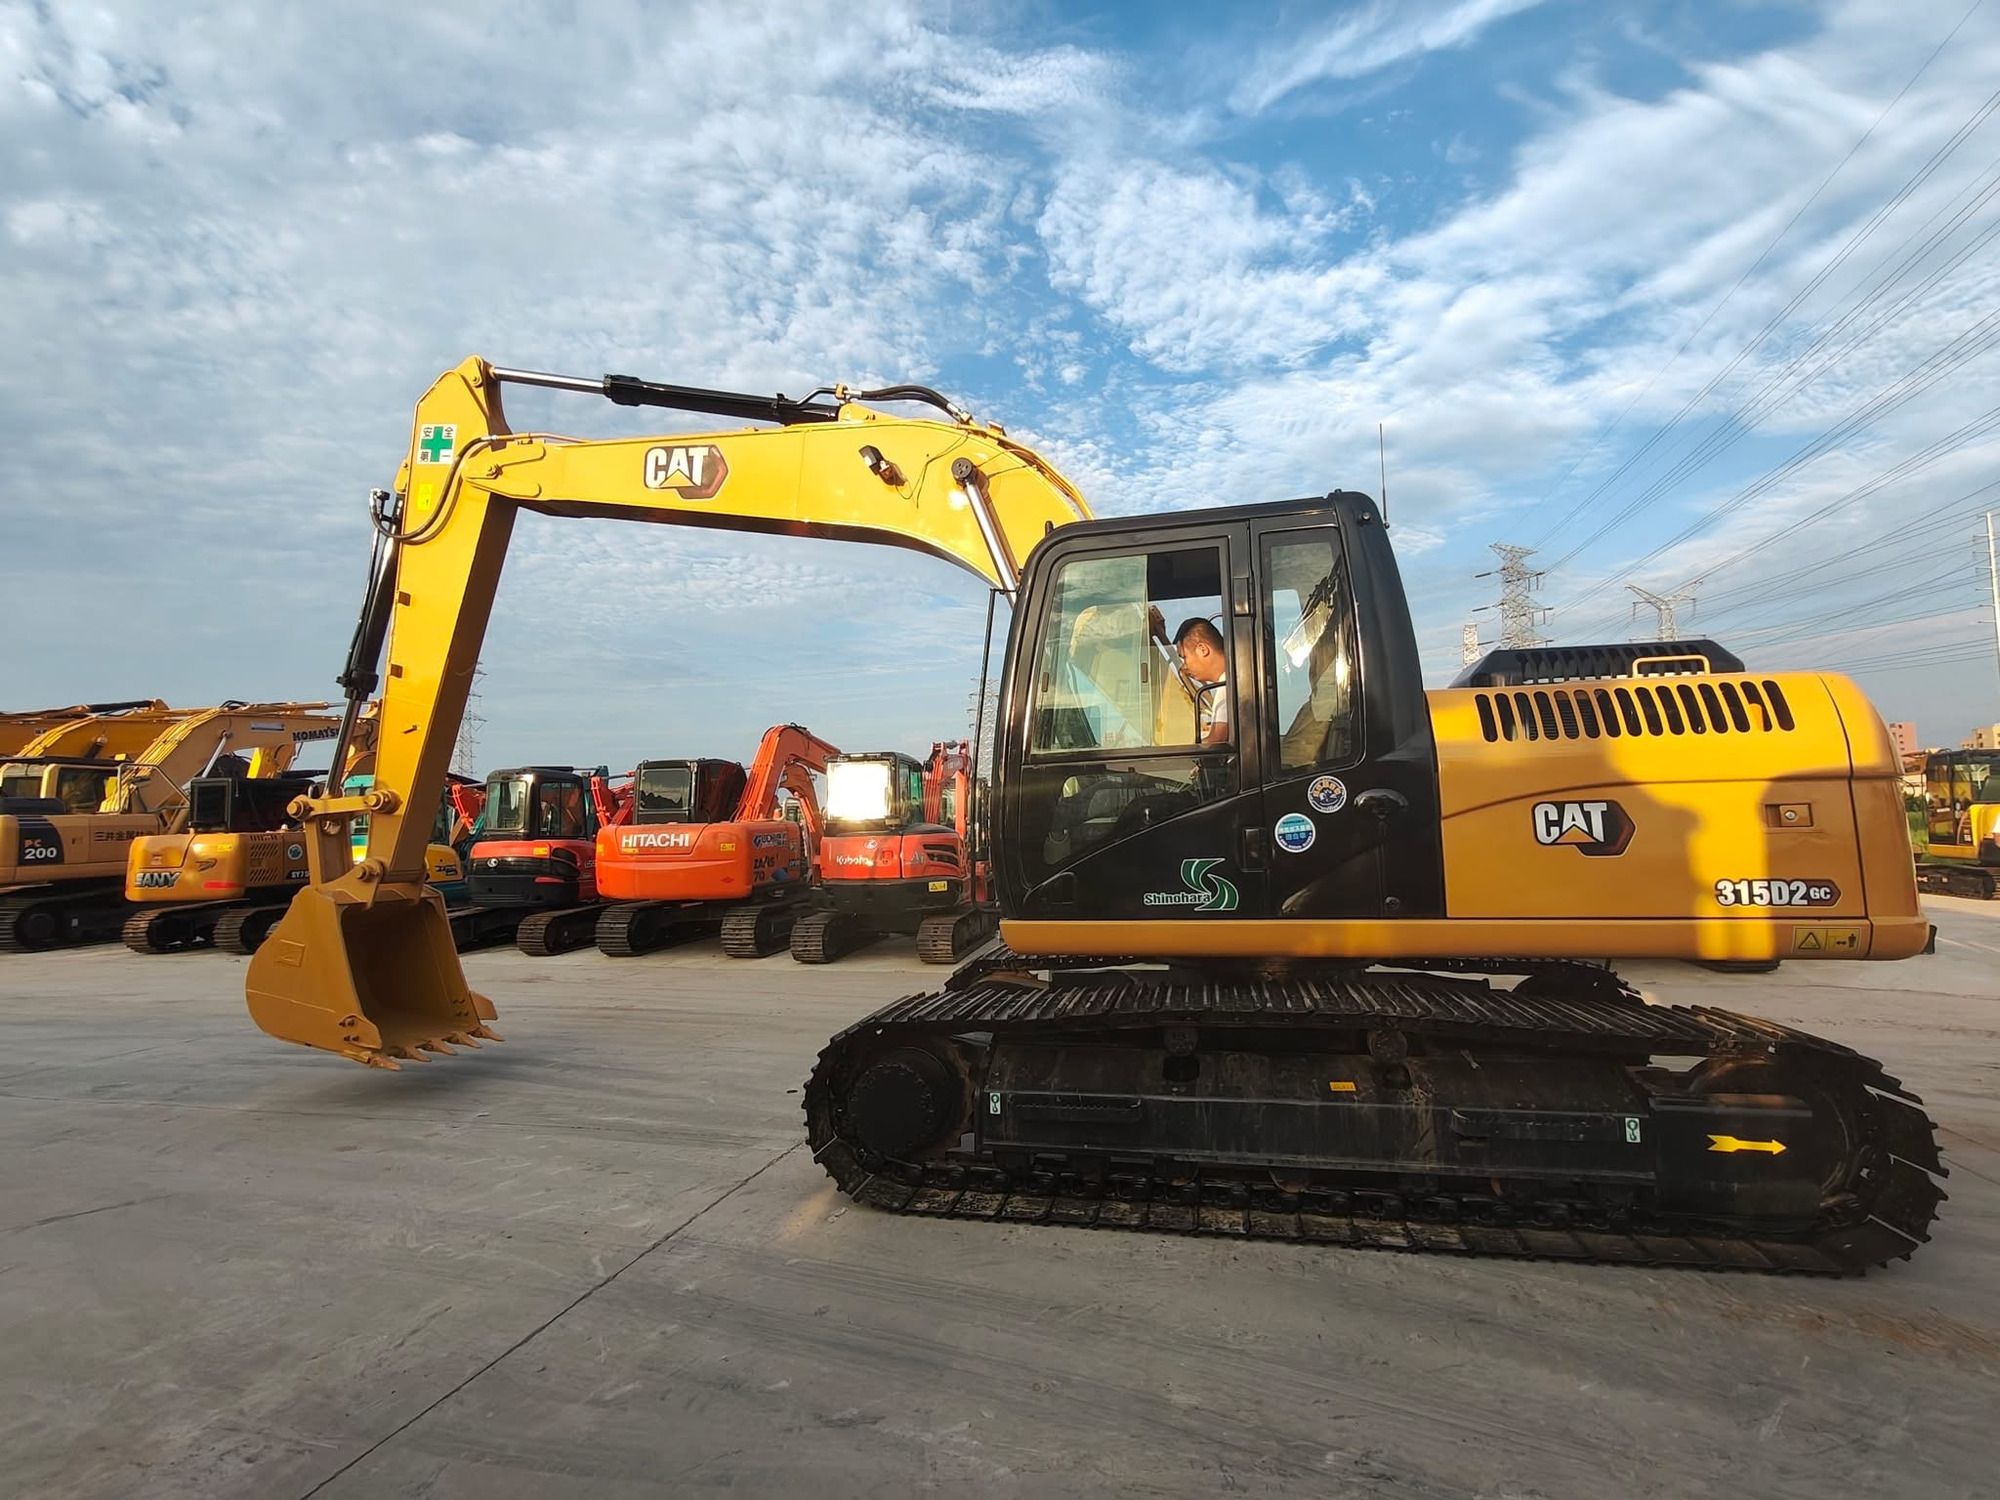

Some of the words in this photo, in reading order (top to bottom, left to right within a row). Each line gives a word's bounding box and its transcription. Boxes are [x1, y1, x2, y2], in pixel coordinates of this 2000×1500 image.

[645, 446, 709, 489] CAT
[1534, 802, 1607, 844] CAT
[24, 839, 42, 848] PC
[621, 832, 690, 848] HITACHI
[24, 847, 57, 860] 200
[135, 871, 181, 888] SANY
[1144, 892, 1212, 906] Shinohara
[1716, 880, 1808, 906] 315D2
[1809, 887, 1831, 900] GC
